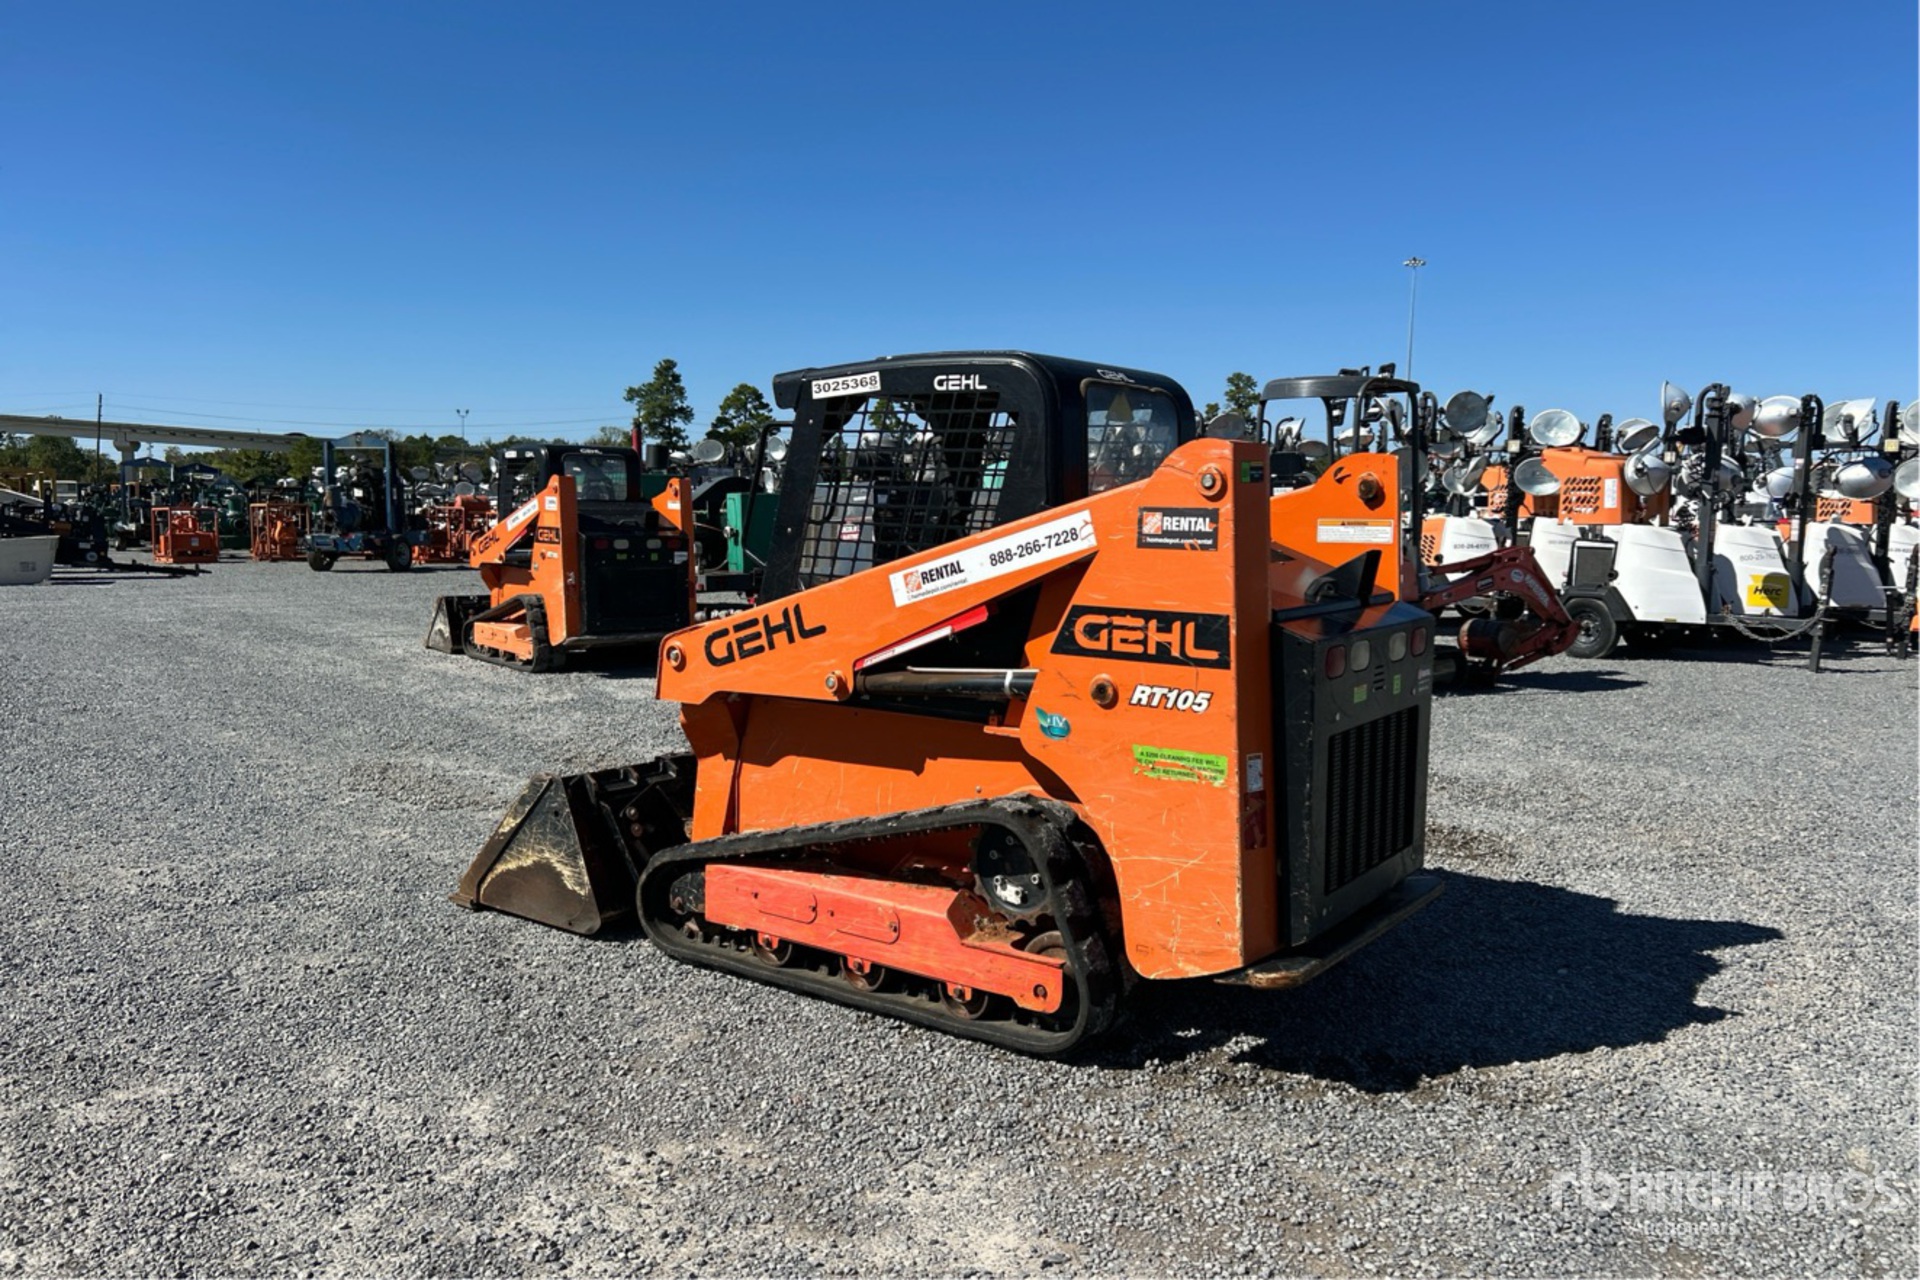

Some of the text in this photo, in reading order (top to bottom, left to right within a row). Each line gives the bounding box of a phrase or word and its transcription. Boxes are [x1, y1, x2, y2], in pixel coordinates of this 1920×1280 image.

[813, 375, 878, 394] 3025368
[933, 374, 987, 391] GEHL
[1163, 516, 1213, 532] RENTAL
[989, 527, 1079, 567] 888-266-7228
[1146, 537, 1213, 545] homedepot.comrental
[920, 560, 965, 585] RENTAL
[1753, 585, 1782, 597] Herc
[704, 603, 827, 667] GEHL
[1074, 614, 1220, 660] GEHL
[1129, 683, 1214, 713] RT105
[1160, 752, 1191, 762] CLEANING
[1205, 759, 1221, 767] WILL
